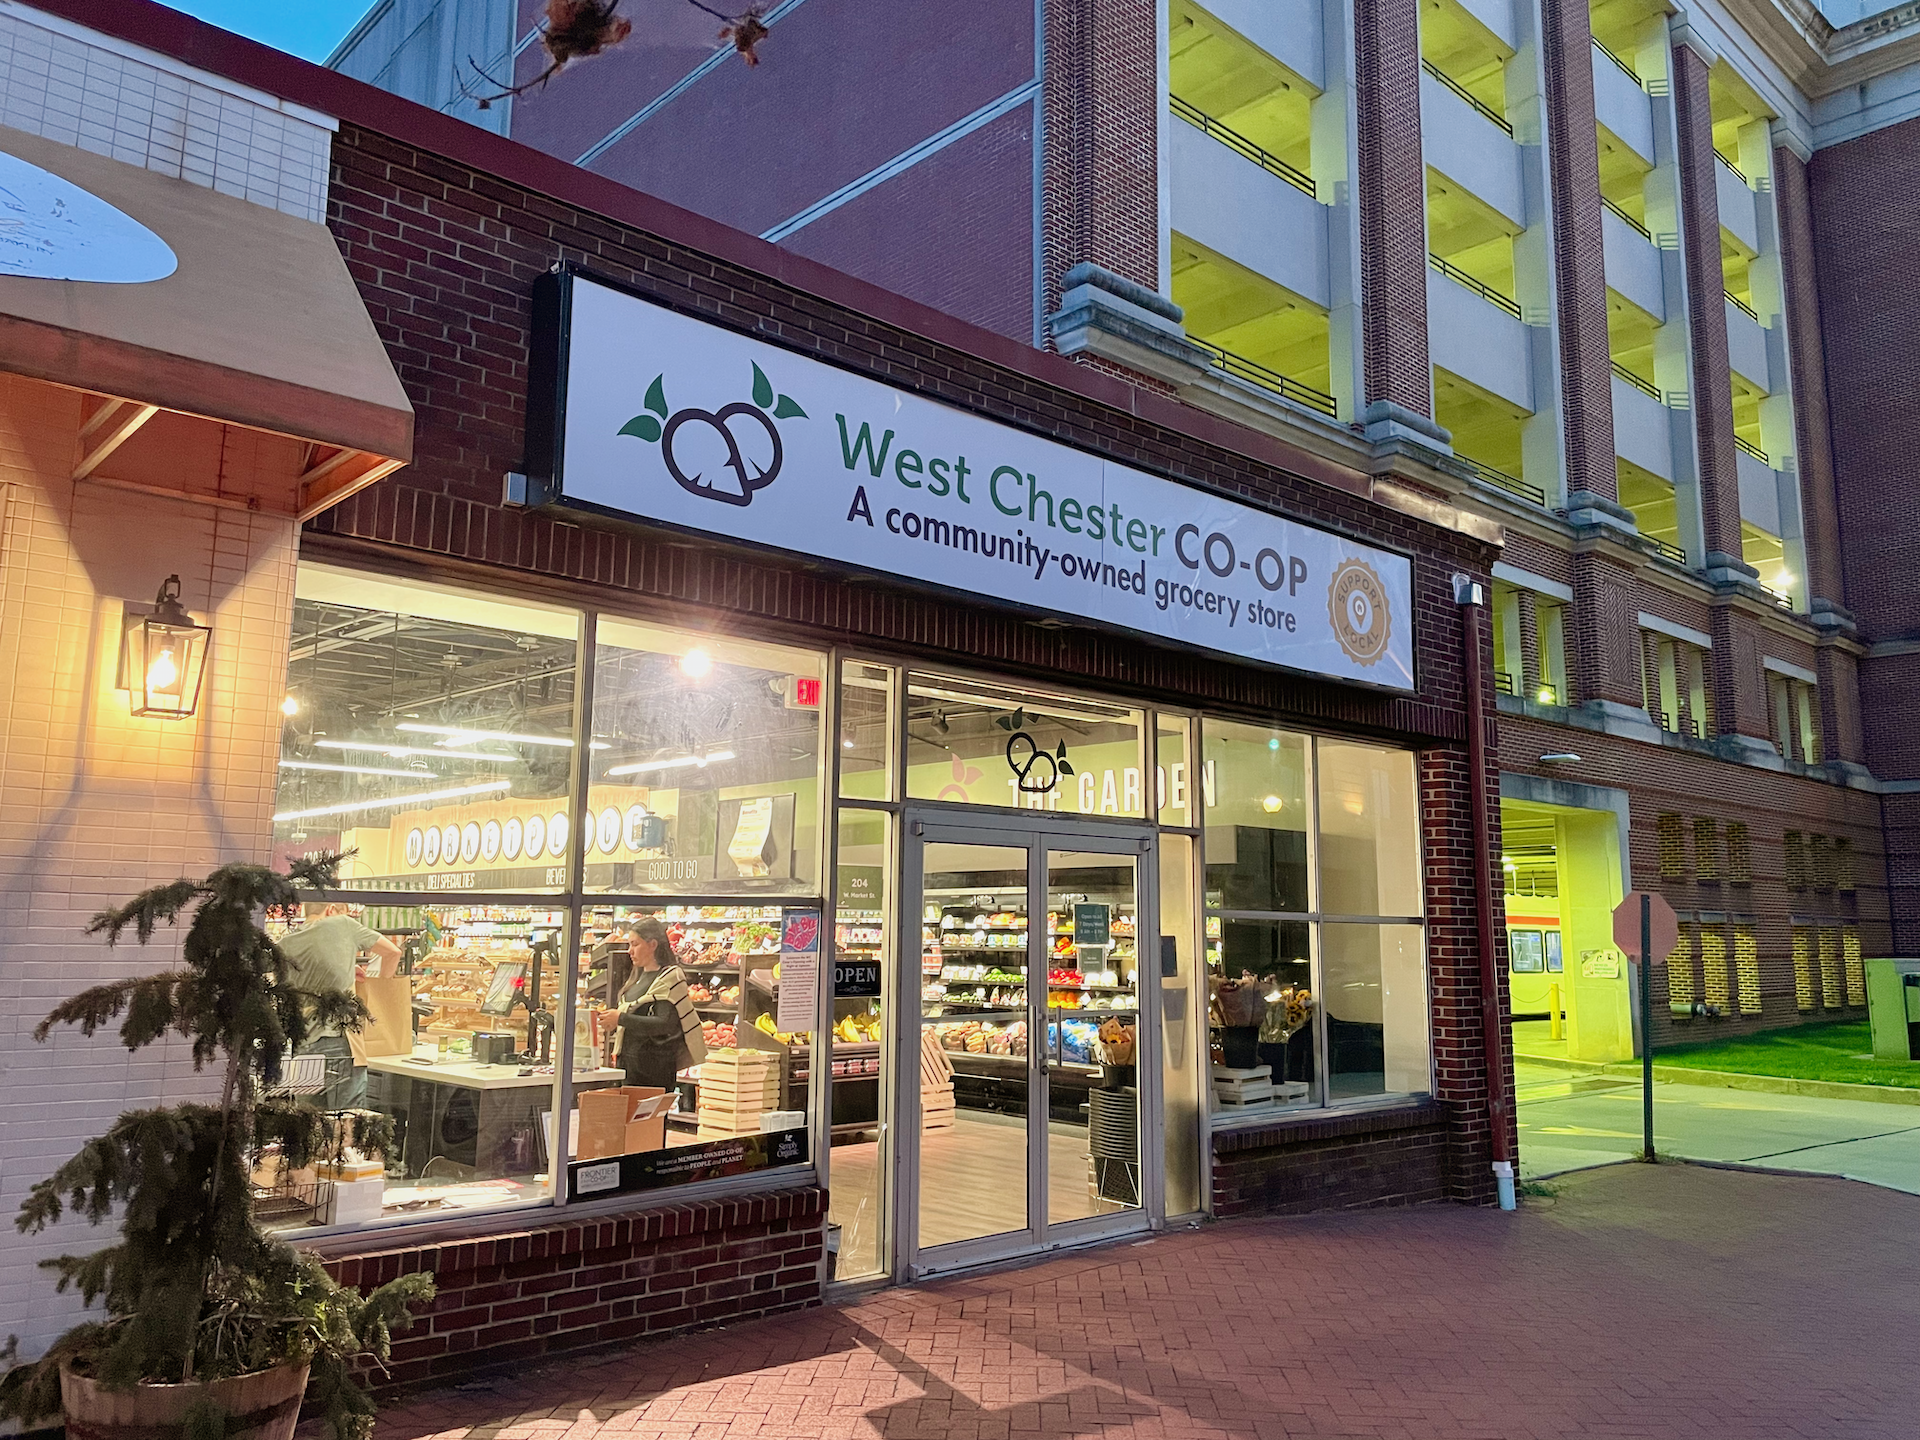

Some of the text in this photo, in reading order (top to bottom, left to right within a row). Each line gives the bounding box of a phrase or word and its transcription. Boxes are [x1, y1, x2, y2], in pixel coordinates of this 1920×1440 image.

[835, 413, 1308, 597] West Chester CO-OP
[847, 485, 1297, 633] A community-owned grocery store
[1338, 574, 1382, 611] SUPPORT
[1344, 625, 1379, 649] LOCAL
[1008, 774, 1064, 812] THE
[427, 872, 475, 890] DELI SPECIALTIES
[648, 860, 698, 881] GOOD TO GO
[851, 878, 868, 888] 204
[834, 967, 876, 983] OPEN
[581, 1166, 616, 1179] FRONTIER
[690, 1160, 711, 1169] PEOPLE
[722, 1155, 743, 1164] PLANET
